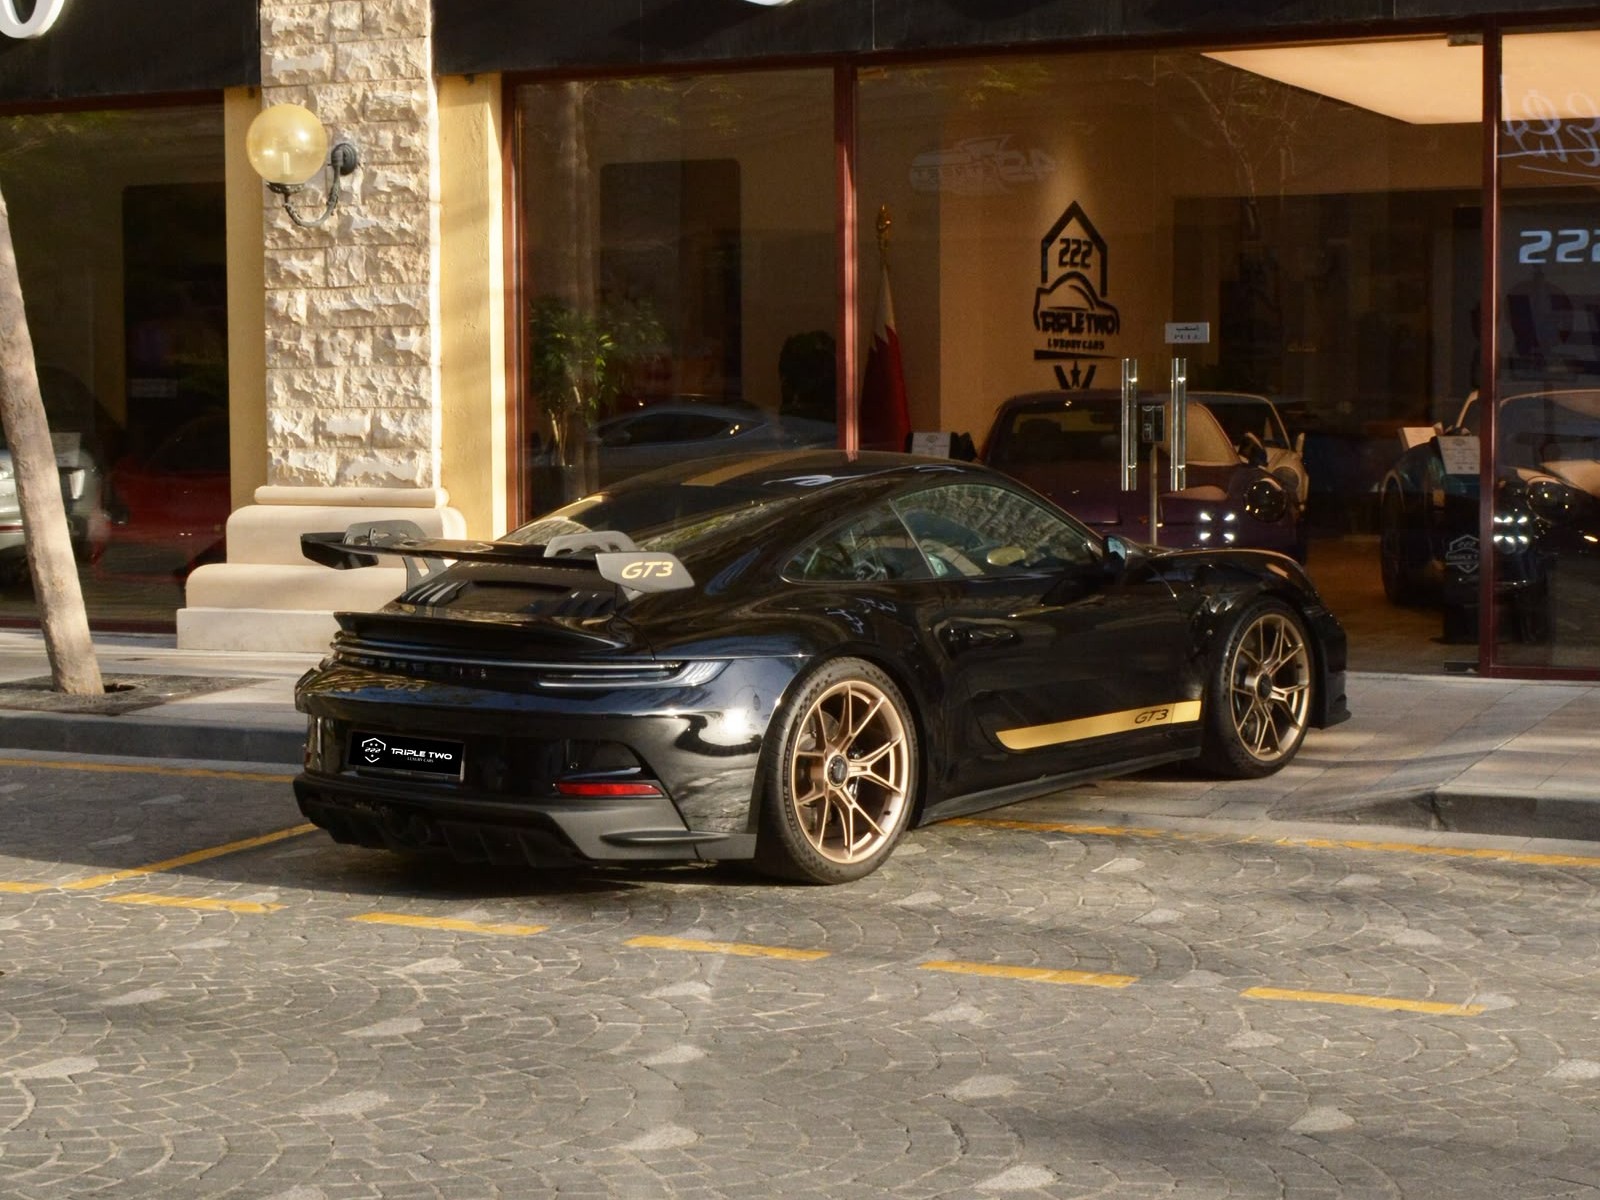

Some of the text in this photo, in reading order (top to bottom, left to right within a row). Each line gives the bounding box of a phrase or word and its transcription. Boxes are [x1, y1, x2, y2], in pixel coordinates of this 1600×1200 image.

[1059, 238, 1093, 268] 222
[1519, 229, 1600, 263] 22
[621, 561, 674, 579] GT3
[1134, 708, 1169, 724] GT3
[391, 748, 453, 760] TRIPLE TWO
